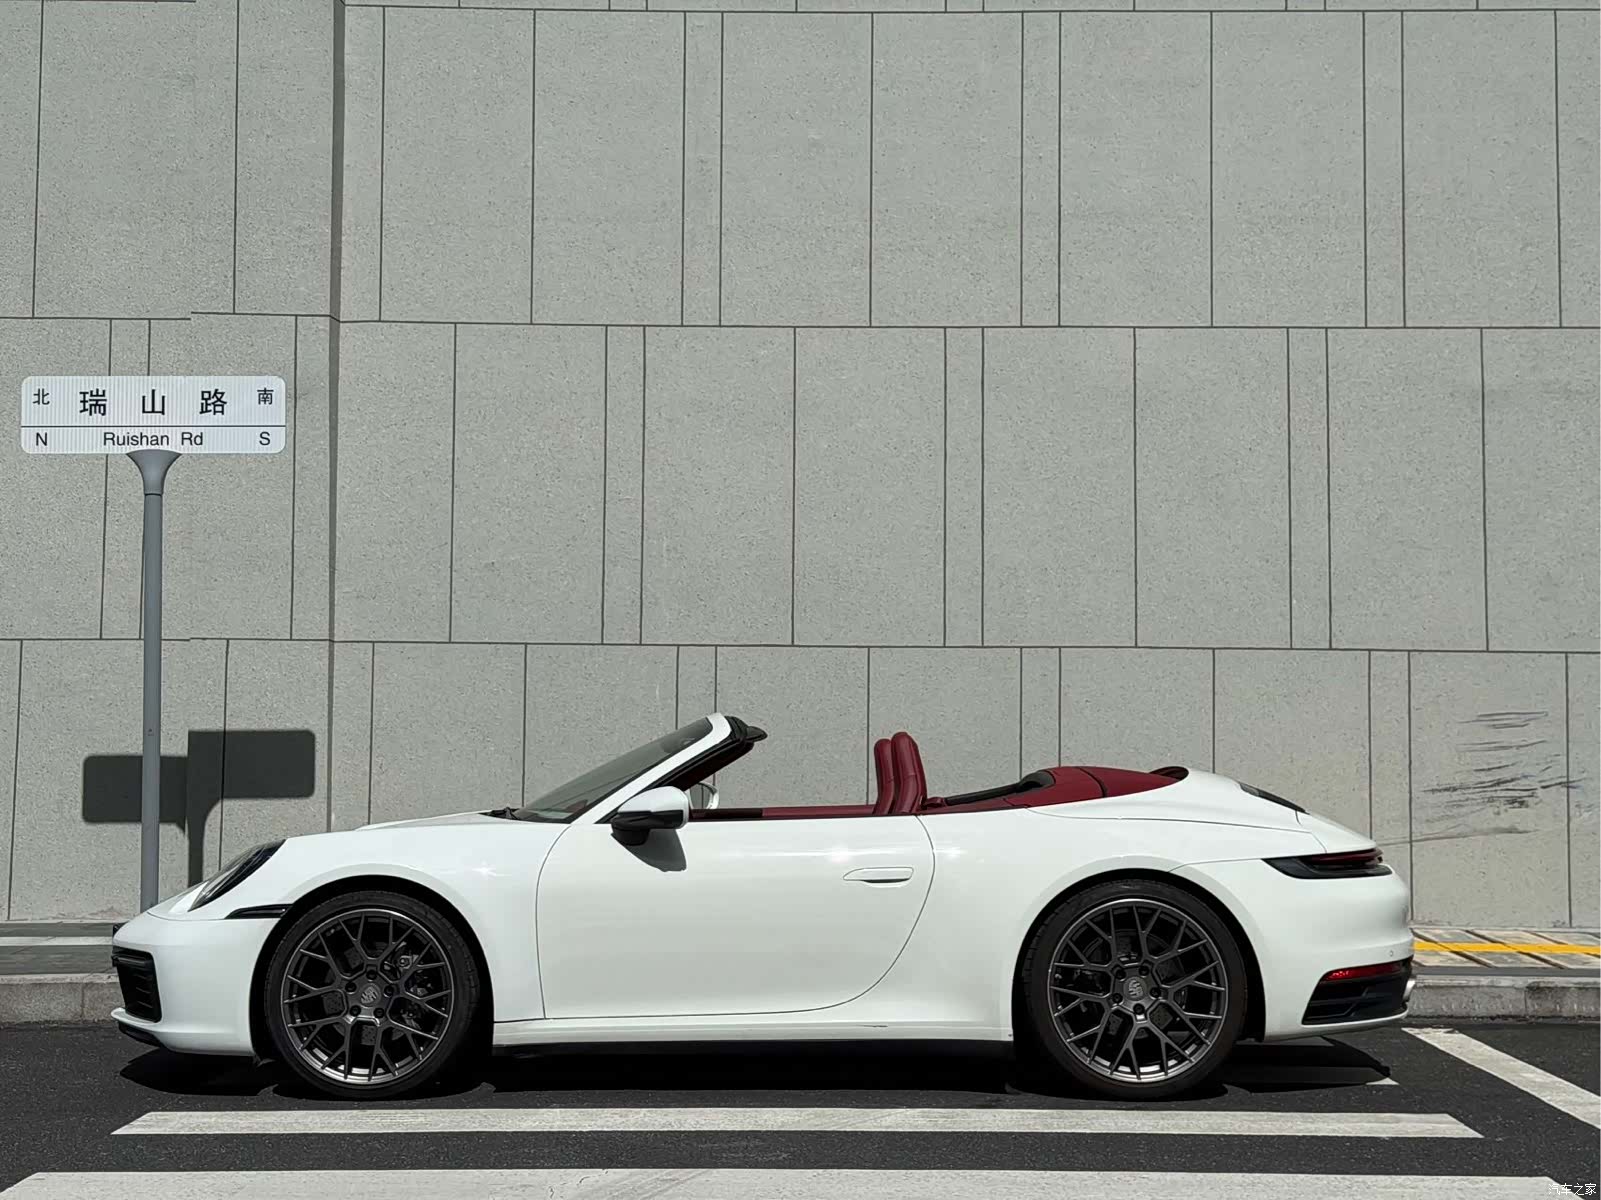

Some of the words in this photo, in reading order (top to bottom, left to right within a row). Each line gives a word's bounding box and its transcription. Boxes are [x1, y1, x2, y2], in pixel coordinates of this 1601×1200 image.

[33, 388, 51, 406] 北
[79, 388, 228, 416] 瑞山路
[256, 387, 274, 405] 南
[35, 432, 48, 446] N
[103, 431, 170, 446] Ruishan
[181, 431, 204, 446] Rd
[259, 431, 271, 446] S
